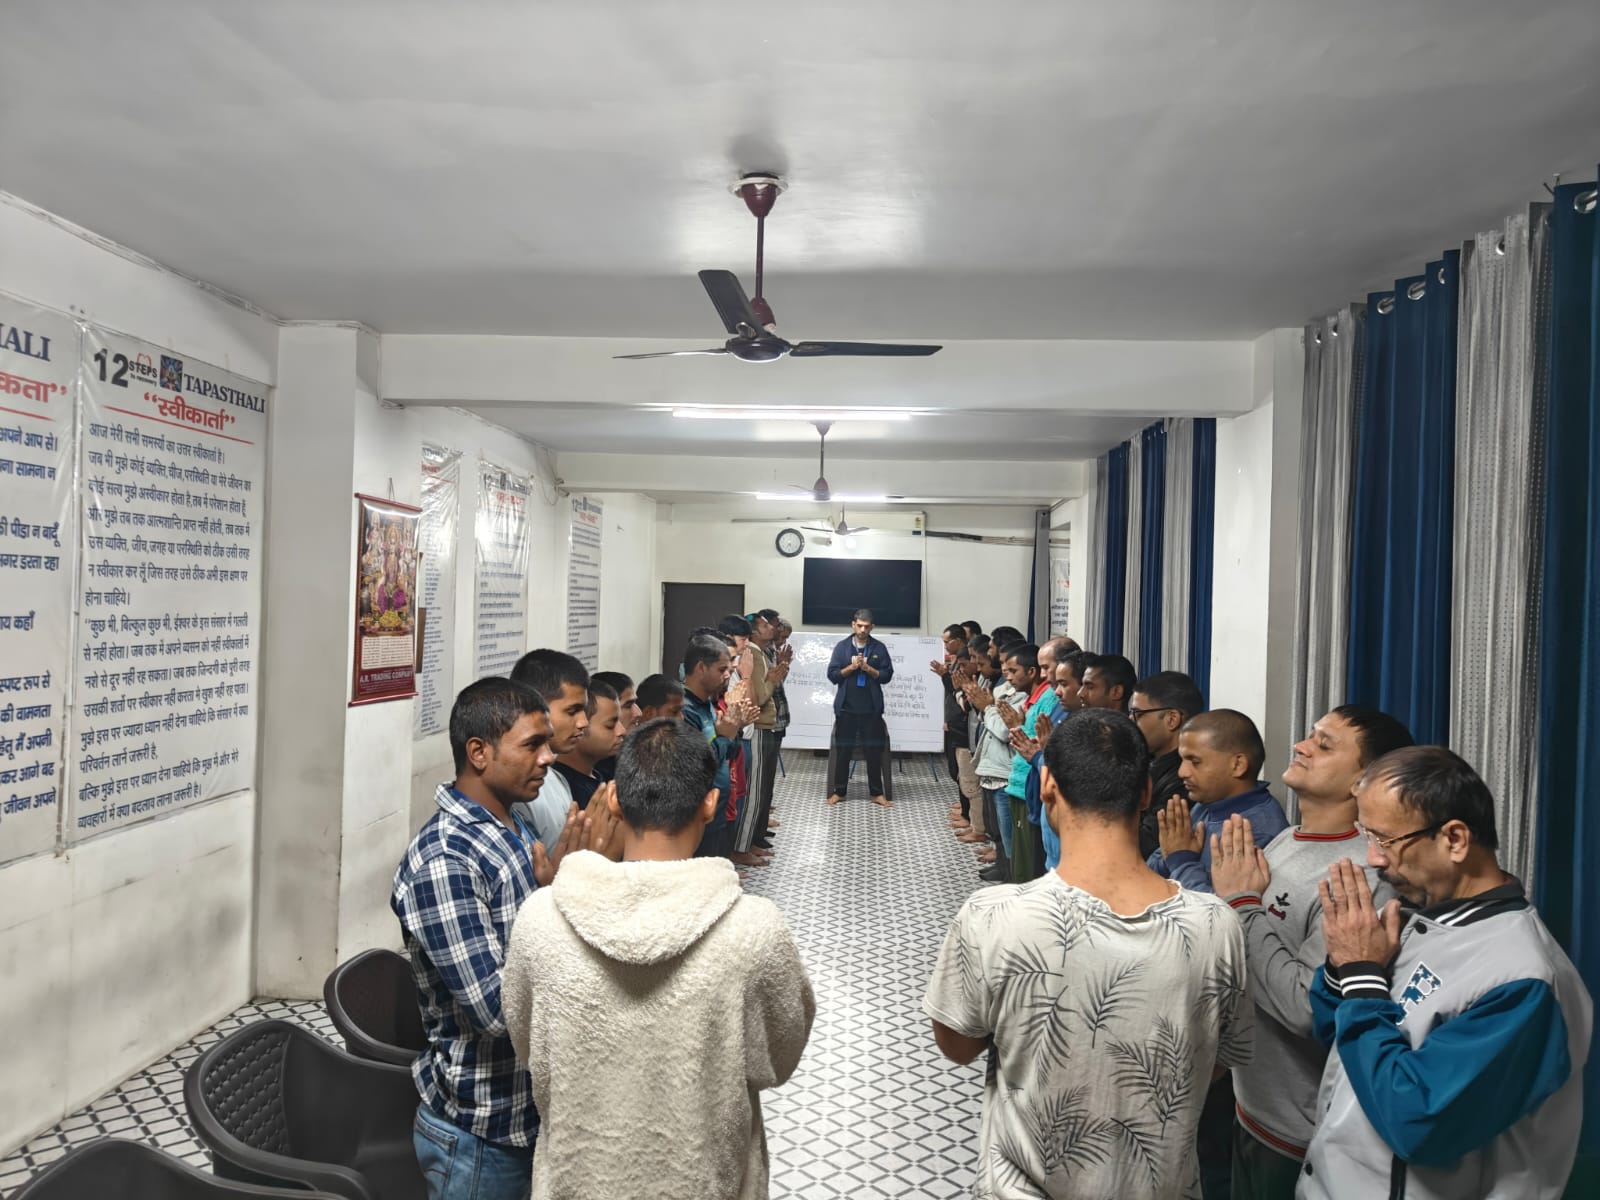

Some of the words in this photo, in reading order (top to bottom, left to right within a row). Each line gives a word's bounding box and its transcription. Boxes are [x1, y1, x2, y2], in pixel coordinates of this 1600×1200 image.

[94, 347, 129, 388] 12
[128, 360, 158, 378] STEPS
[183, 373, 266, 414] TAPASTHALI
[24, 432, 43, 449] आप
[89, 422, 108, 439] आज
[110, 422, 123, 442] मेरी
[166, 441, 175, 455] का
[16, 461, 45, 479] सामना
[48, 467, 56, 480] न
[88, 450, 103, 466] जब
[104, 449, 113, 468] भी
[115, 452, 128, 474] मुझे
[129, 455, 145, 476] कोई
[210, 473, 217, 486] या
[106, 482, 123, 497] सत्य
[124, 481, 137, 504] मुझे
[139, 483, 170, 505] अस्वीकार
[171, 488, 184, 506] होता
[209, 493, 228, 512] परेशान
[32, 525, 40, 539] न
[104, 505, 118, 528] मुझे
[119, 511, 131, 524] तब
[132, 512, 145, 526] तक
[182, 518, 197, 532] प्राप्त
[225, 523, 234, 535] तब
[234, 524, 245, 536] तक
[88, 535, 103, 550] उस
[168, 542, 175, 554] या
[212, 541, 225, 557] ठीक
[225, 543, 237, 559] उसी
[239, 547, 250, 560] तरह
[20, 555, 42, 570] डरता
[44, 556, 60, 571] रहा
[88, 563, 95, 577] न
[96, 559, 123, 578] स्वीकार
[125, 565, 138, 579] कर
[147, 561, 164, 580] जिस
[164, 567, 179, 581] तरह
[179, 564, 191, 581] उसे
[192, 564, 206, 581] ठीक
[240, 570, 248, 582] पर
[85, 587, 102, 607] होना
[120, 614, 147, 637] बिल्कुल
[147, 618, 161, 636] कुछ
[191, 613, 199, 628] के
[199, 616, 210, 631] इस
[83, 642, 91, 661] से
[92, 641, 107, 661] नहीं
[130, 644, 143, 657] जब
[144, 644, 157, 656] तक
[165, 637, 182, 655] अपने
[182, 641, 201, 654] व्यसन
[201, 637, 210, 652] को
[42, 670, 51, 689] से
[84, 670, 99, 689] नशे
[100, 669, 108, 688] से
[109, 673, 121, 691] दूर
[137, 670, 147, 684] रह
[173, 667, 184, 679] जब
[185, 666, 197, 678] तक
[220, 658, 228, 673] को
[84, 696, 109, 717] उसकी
[127, 698, 137, 711] पर
[138, 691, 163, 708] स्वीकार
[176, 690, 195, 703] करता
[225, 684, 234, 696] रह
[26, 727, 52, 751] अपनी
[80, 726, 95, 752] मुझे
[96, 729, 109, 746] इस
[111, 727, 121, 740] पर
[122, 723, 143, 737] ज्यादा
[144, 720, 161, 733] ध्यान
[175, 712, 188, 728] देना
[207, 706, 216, 723] कि
[18, 760, 40, 781] आगे
[79, 752, 111, 773] परिवर्तन
[78, 782, 100, 802] बल्कि
[101, 777, 114, 802] मुझे
[116, 778, 129, 794] इस
[130, 775, 140, 788] पर
[141, 771, 157, 785] ध्यान
[158, 764, 171, 781] देना
[192, 757, 201, 774] कि
[219, 750, 230, 766] और
[4, 793, 31, 815] जीवन
[33, 786, 56, 809] अपने
[77, 804, 107, 828] व्यवहारों
[108, 802, 116, 821] में
[116, 803, 130, 819] क्या
[131, 797, 155, 814] बदलाव
[156, 792, 173, 808] लाना
